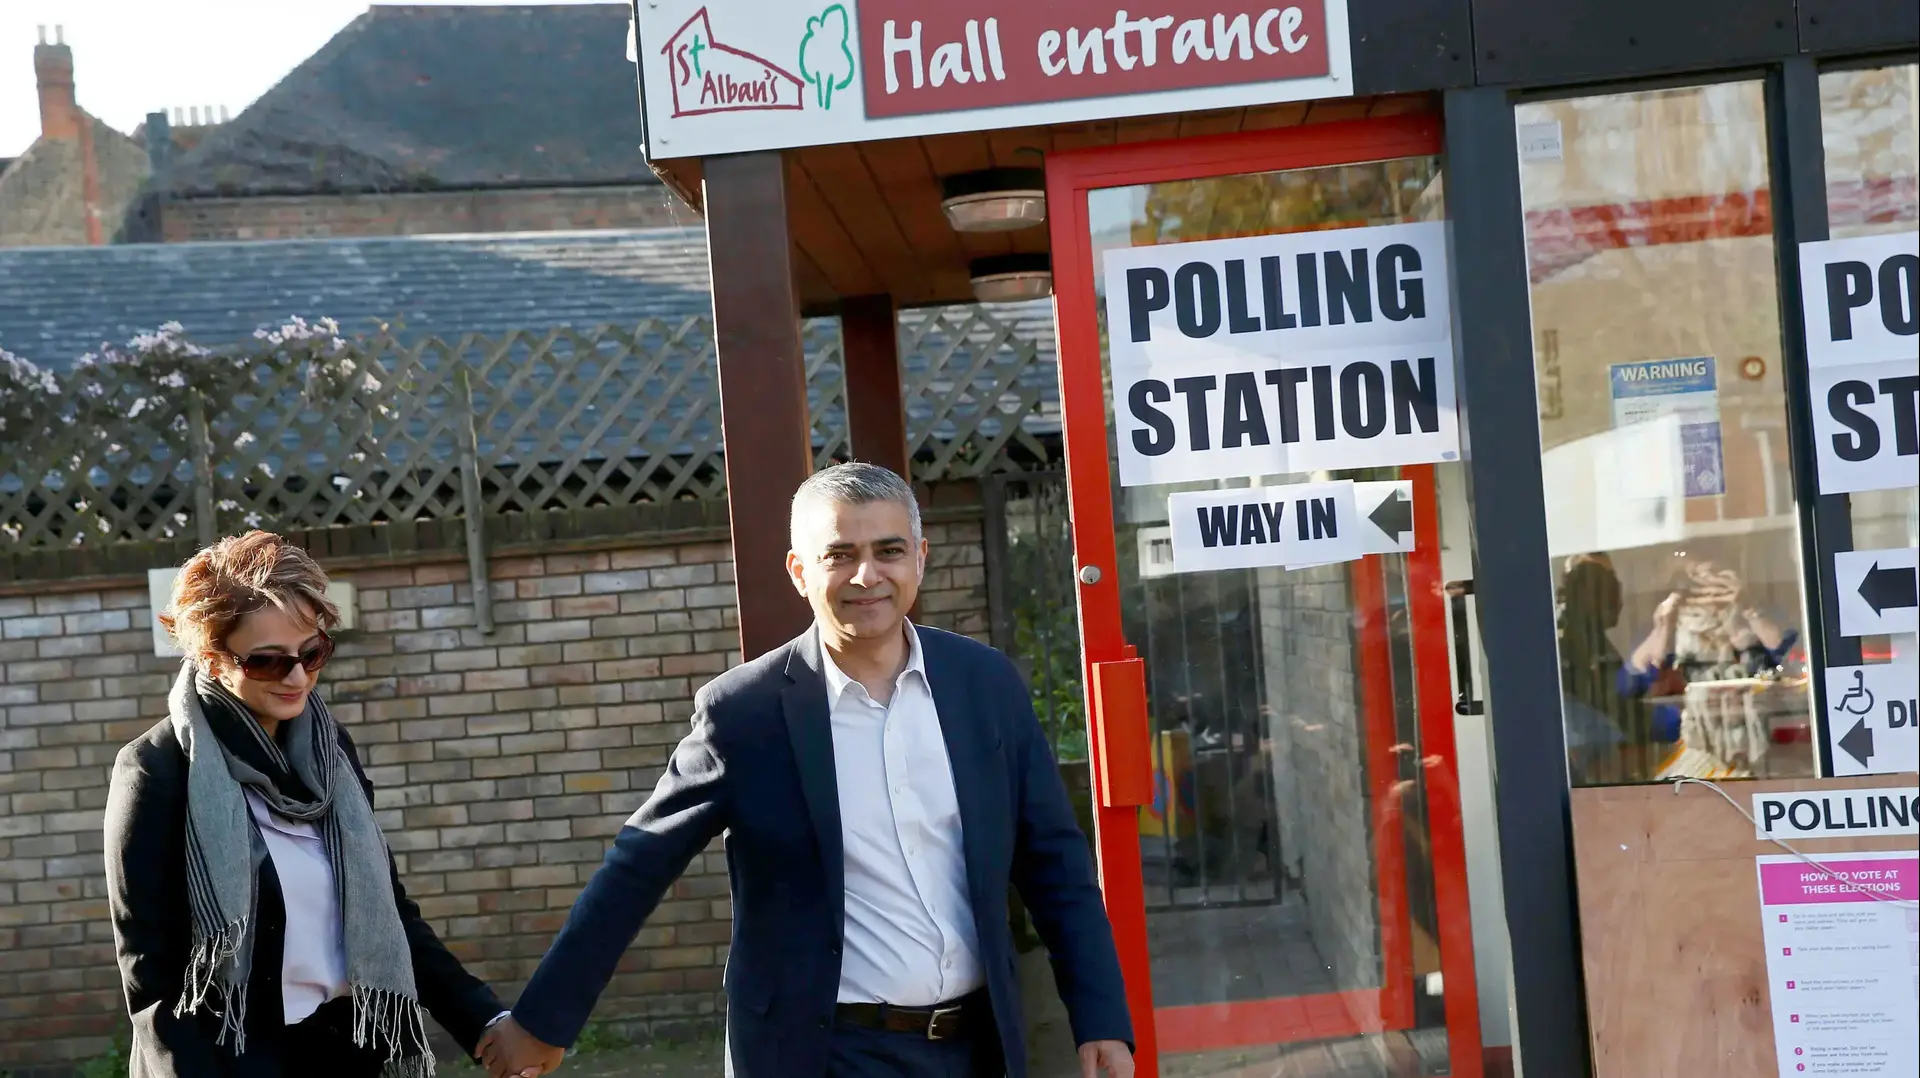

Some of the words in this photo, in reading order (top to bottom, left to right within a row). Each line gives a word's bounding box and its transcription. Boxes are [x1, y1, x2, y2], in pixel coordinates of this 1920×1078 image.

[676, 34, 705, 87] St
[700, 70, 778, 105] Alban's
[883, 16, 1006, 94] Hall
[1037, 6, 1309, 77] entrance
[1126, 243, 1426, 343] POLLING
[1620, 361, 1706, 382] WARNING
[1128, 357, 1440, 456] STATION
[1197, 501, 1285, 548] WAY
[1295, 497, 1338, 541] IN
[1762, 795, 1919, 832] POLLIN
[1800, 872, 1829, 882] HOW
[1834, 871, 1849, 881] TO
[1852, 870, 1882, 880] VOTE
[1884, 870, 1899, 879] AT
[1801, 884, 1837, 894] THESE
[1839, 882, 1901, 894] ELECTIONS
